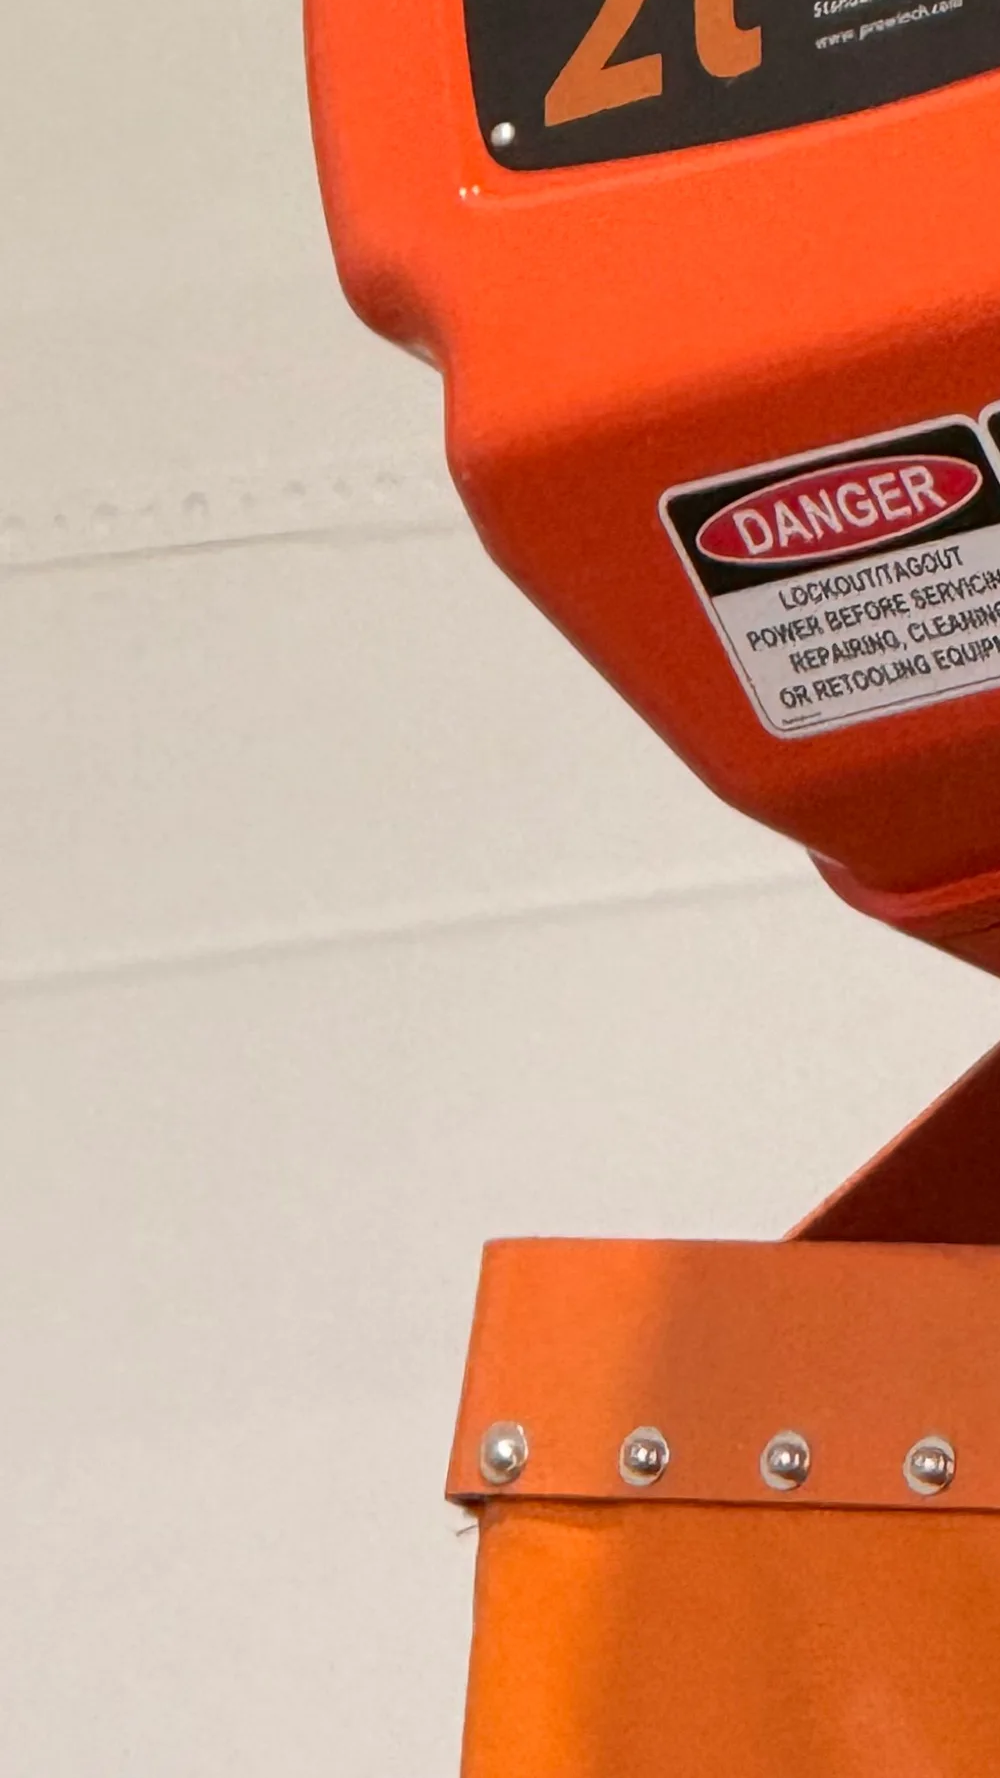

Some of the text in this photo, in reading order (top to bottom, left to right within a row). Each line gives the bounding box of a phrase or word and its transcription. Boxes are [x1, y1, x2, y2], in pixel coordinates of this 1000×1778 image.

[731, 464, 948, 556] DANGER
[778, 544, 965, 612] LOCKOUT/TAGOUT
[746, 613, 824, 653] POWER
[824, 591, 911, 633] BEFORE
[789, 628, 908, 674] REPAIRING,
[779, 683, 812, 710] OR
[816, 653, 932, 702] RETOOLING
